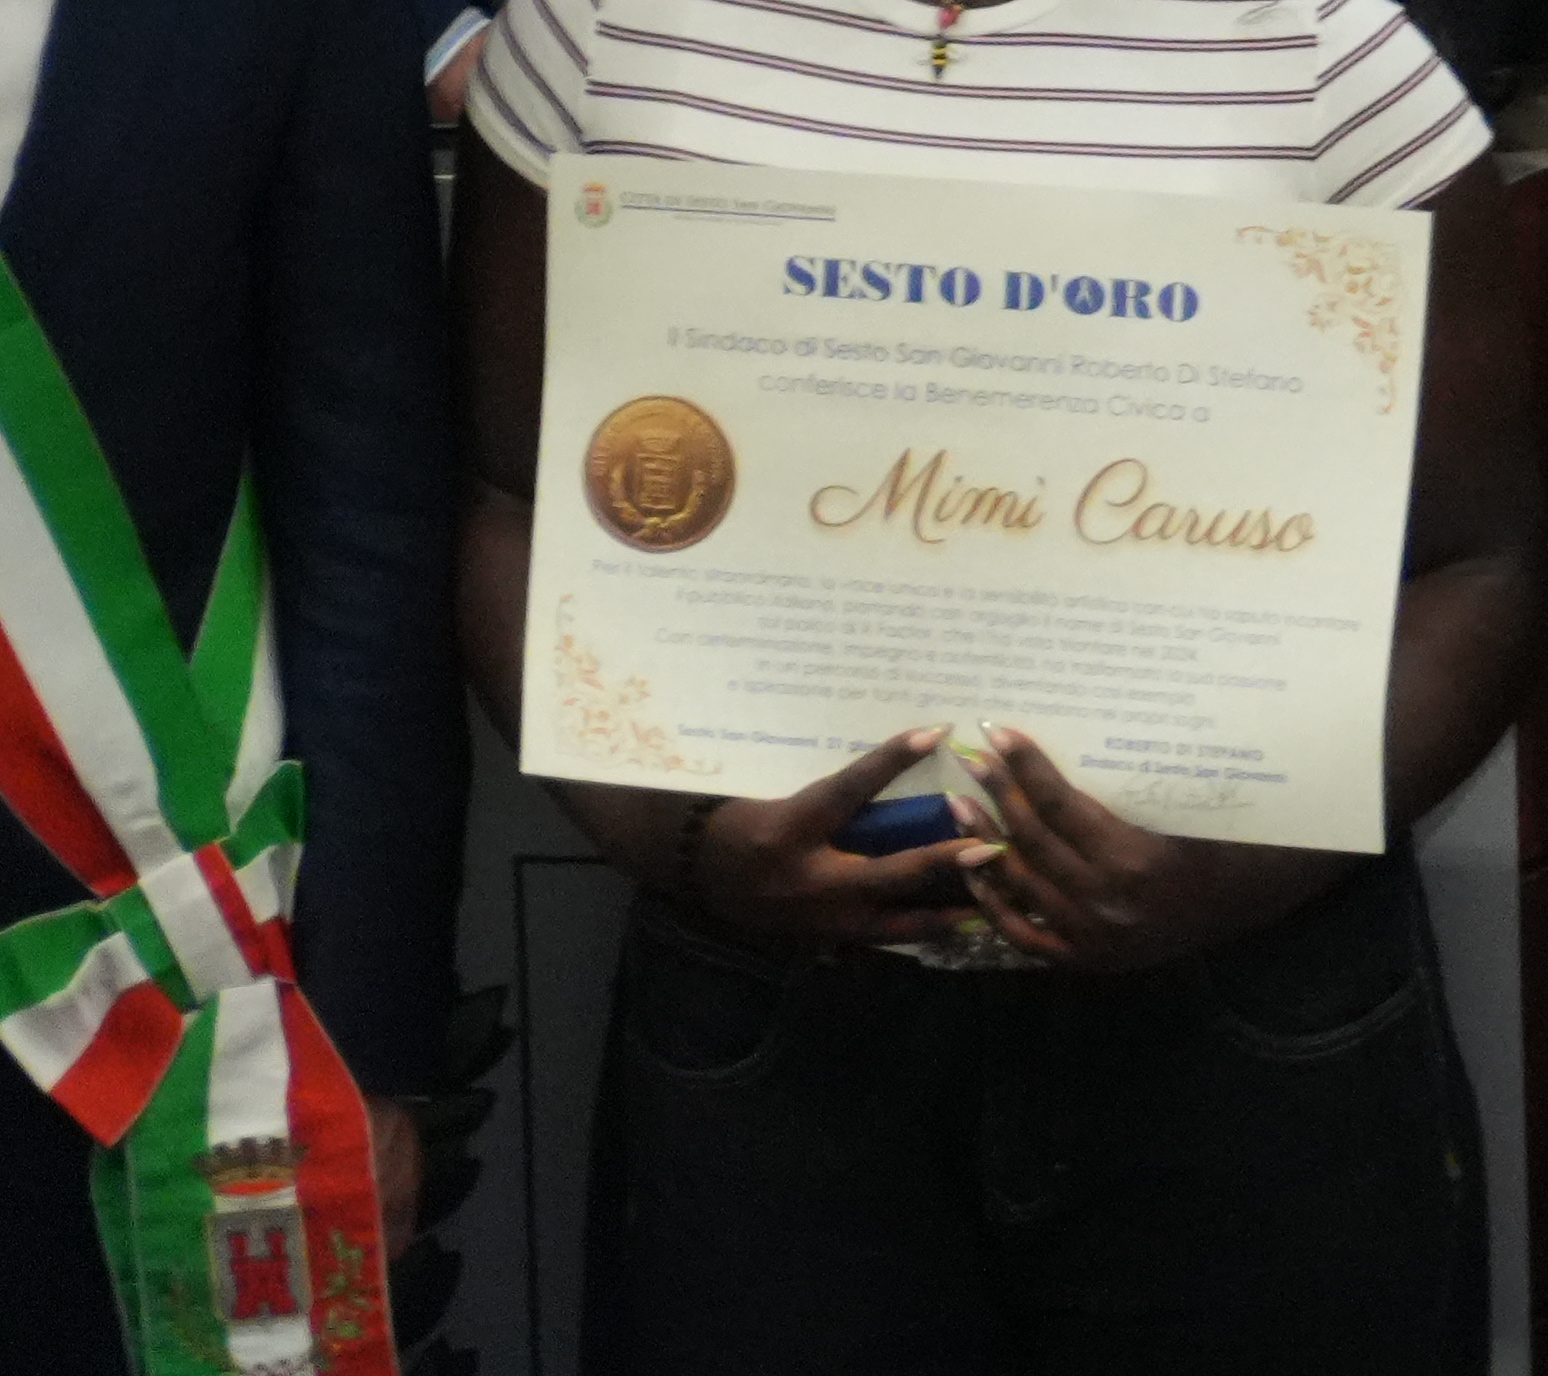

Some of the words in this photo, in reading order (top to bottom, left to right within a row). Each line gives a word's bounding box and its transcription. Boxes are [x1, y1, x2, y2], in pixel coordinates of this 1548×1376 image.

[784, 254, 981, 307] SESTO
[1003, 270, 1200, 323] D'ORO
[807, 448, 1046, 545] Mimi
[1072, 458, 1316, 558] Caruso
